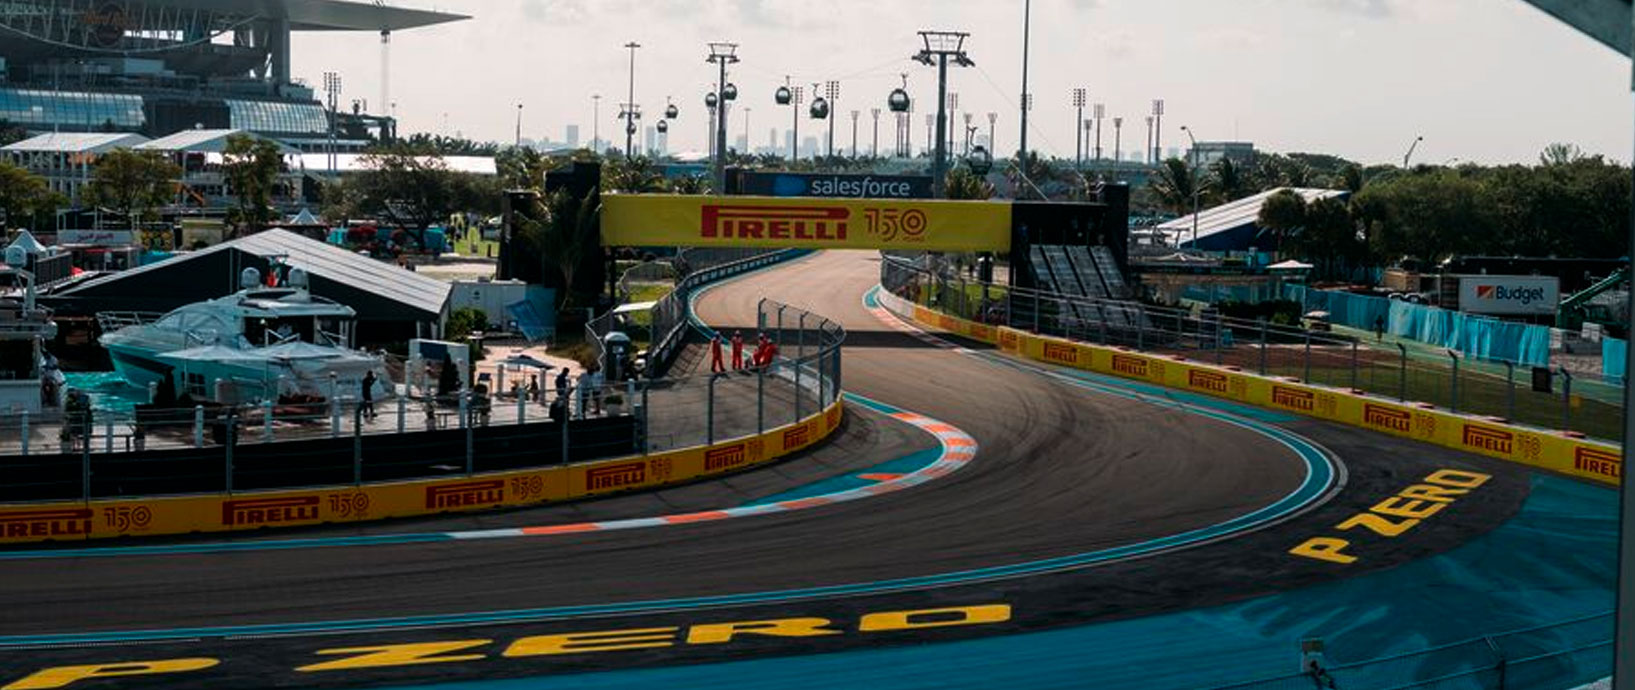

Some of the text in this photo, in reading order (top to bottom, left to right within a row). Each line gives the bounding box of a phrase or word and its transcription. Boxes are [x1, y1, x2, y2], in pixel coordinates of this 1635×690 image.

[811, 177, 911, 198] salesforce
[701, 205, 927, 242] PIRELLI 150
[1496, 285, 1544, 304] Budget
[1112, 354, 1147, 376] PIRELLI
[1189, 369, 1227, 393] PIRELLI
[1273, 386, 1314, 411] PIRELLI
[1364, 403, 1410, 432] PIRELLI
[1463, 424, 1513, 454] PIRELLI
[705, 444, 745, 471] PIRELLI
[1575, 446, 1621, 477] PIREL
[586, 462, 645, 490] PIRELLI
[426, 475, 544, 509] PIRELLI 150
[104, 505, 152, 532] 150
[222, 492, 370, 525] PIRELLI 150
[1288, 469, 1492, 564] P ZERO
[0, 604, 1011, 690] P ZERO
